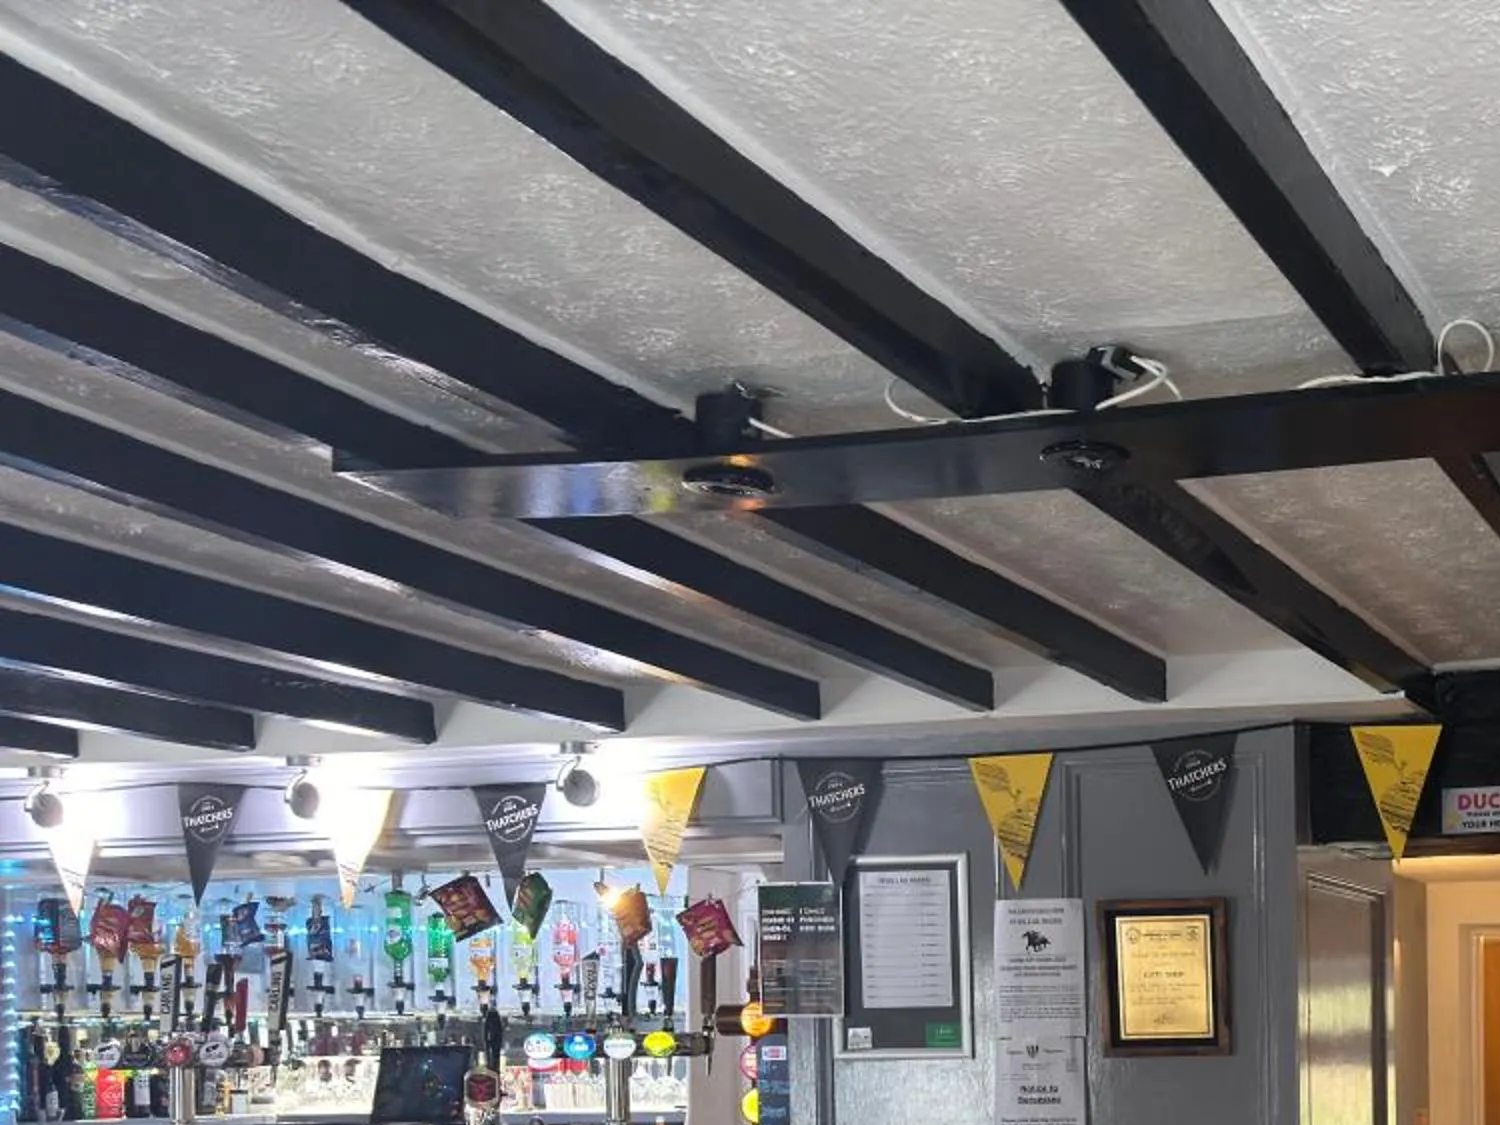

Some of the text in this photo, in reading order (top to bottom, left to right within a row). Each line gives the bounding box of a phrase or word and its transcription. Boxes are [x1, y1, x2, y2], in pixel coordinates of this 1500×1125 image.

[1167, 757, 1227, 790] THATCHERS
[808, 783, 865, 809] THATCHERS
[183, 806, 233, 829] THATCHERS
[486, 803, 538, 832] THATCHERS
